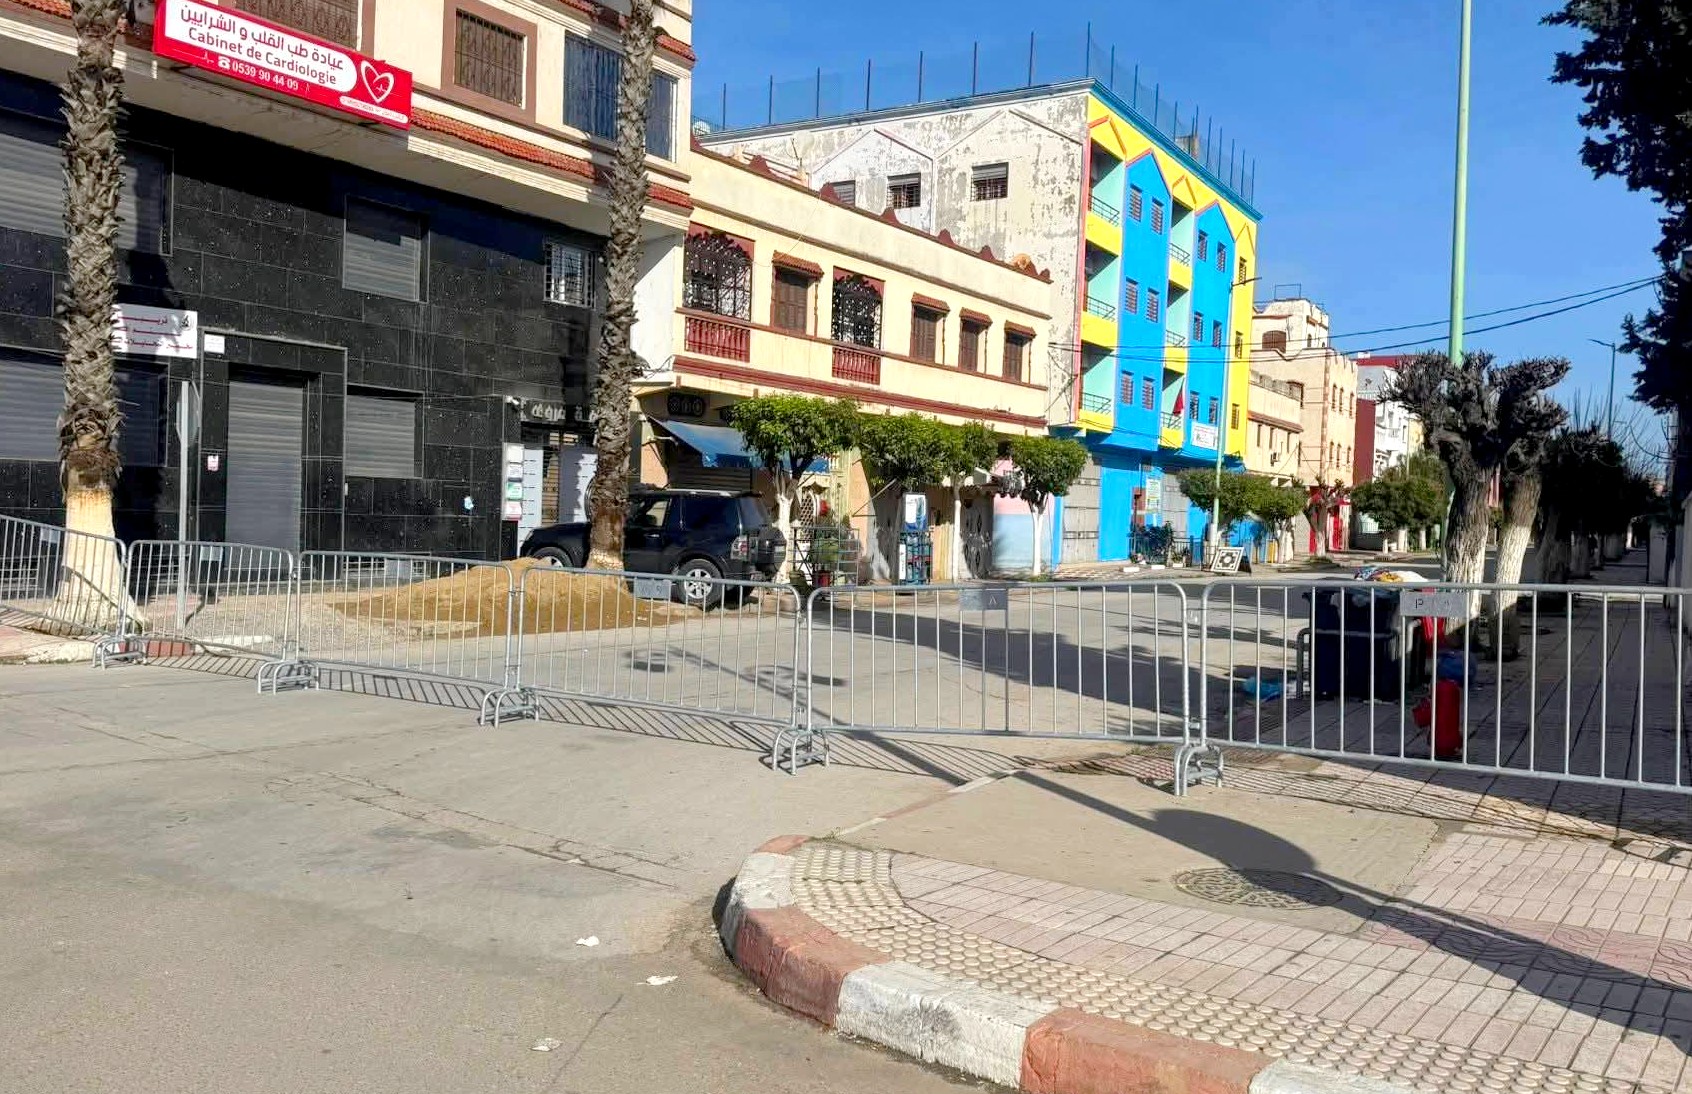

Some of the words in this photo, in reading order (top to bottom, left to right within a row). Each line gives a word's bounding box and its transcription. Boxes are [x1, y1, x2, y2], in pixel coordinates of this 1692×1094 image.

[181, 4, 236, 34] الشرايين
[239, 27, 248, 40] و
[251, 31, 284, 51] القلب
[189, 27, 242, 54] Cabinet
[247, 46, 262, 60] de
[266, 52, 337, 85] Cardiologie
[287, 43, 309, 58] طب
[312, 48, 344, 70] عيادة
[232, 61, 256, 77] 0539
[258, 69, 271, 82] 90
[272, 75, 285, 87] 44
[286, 78, 298, 90] 09
